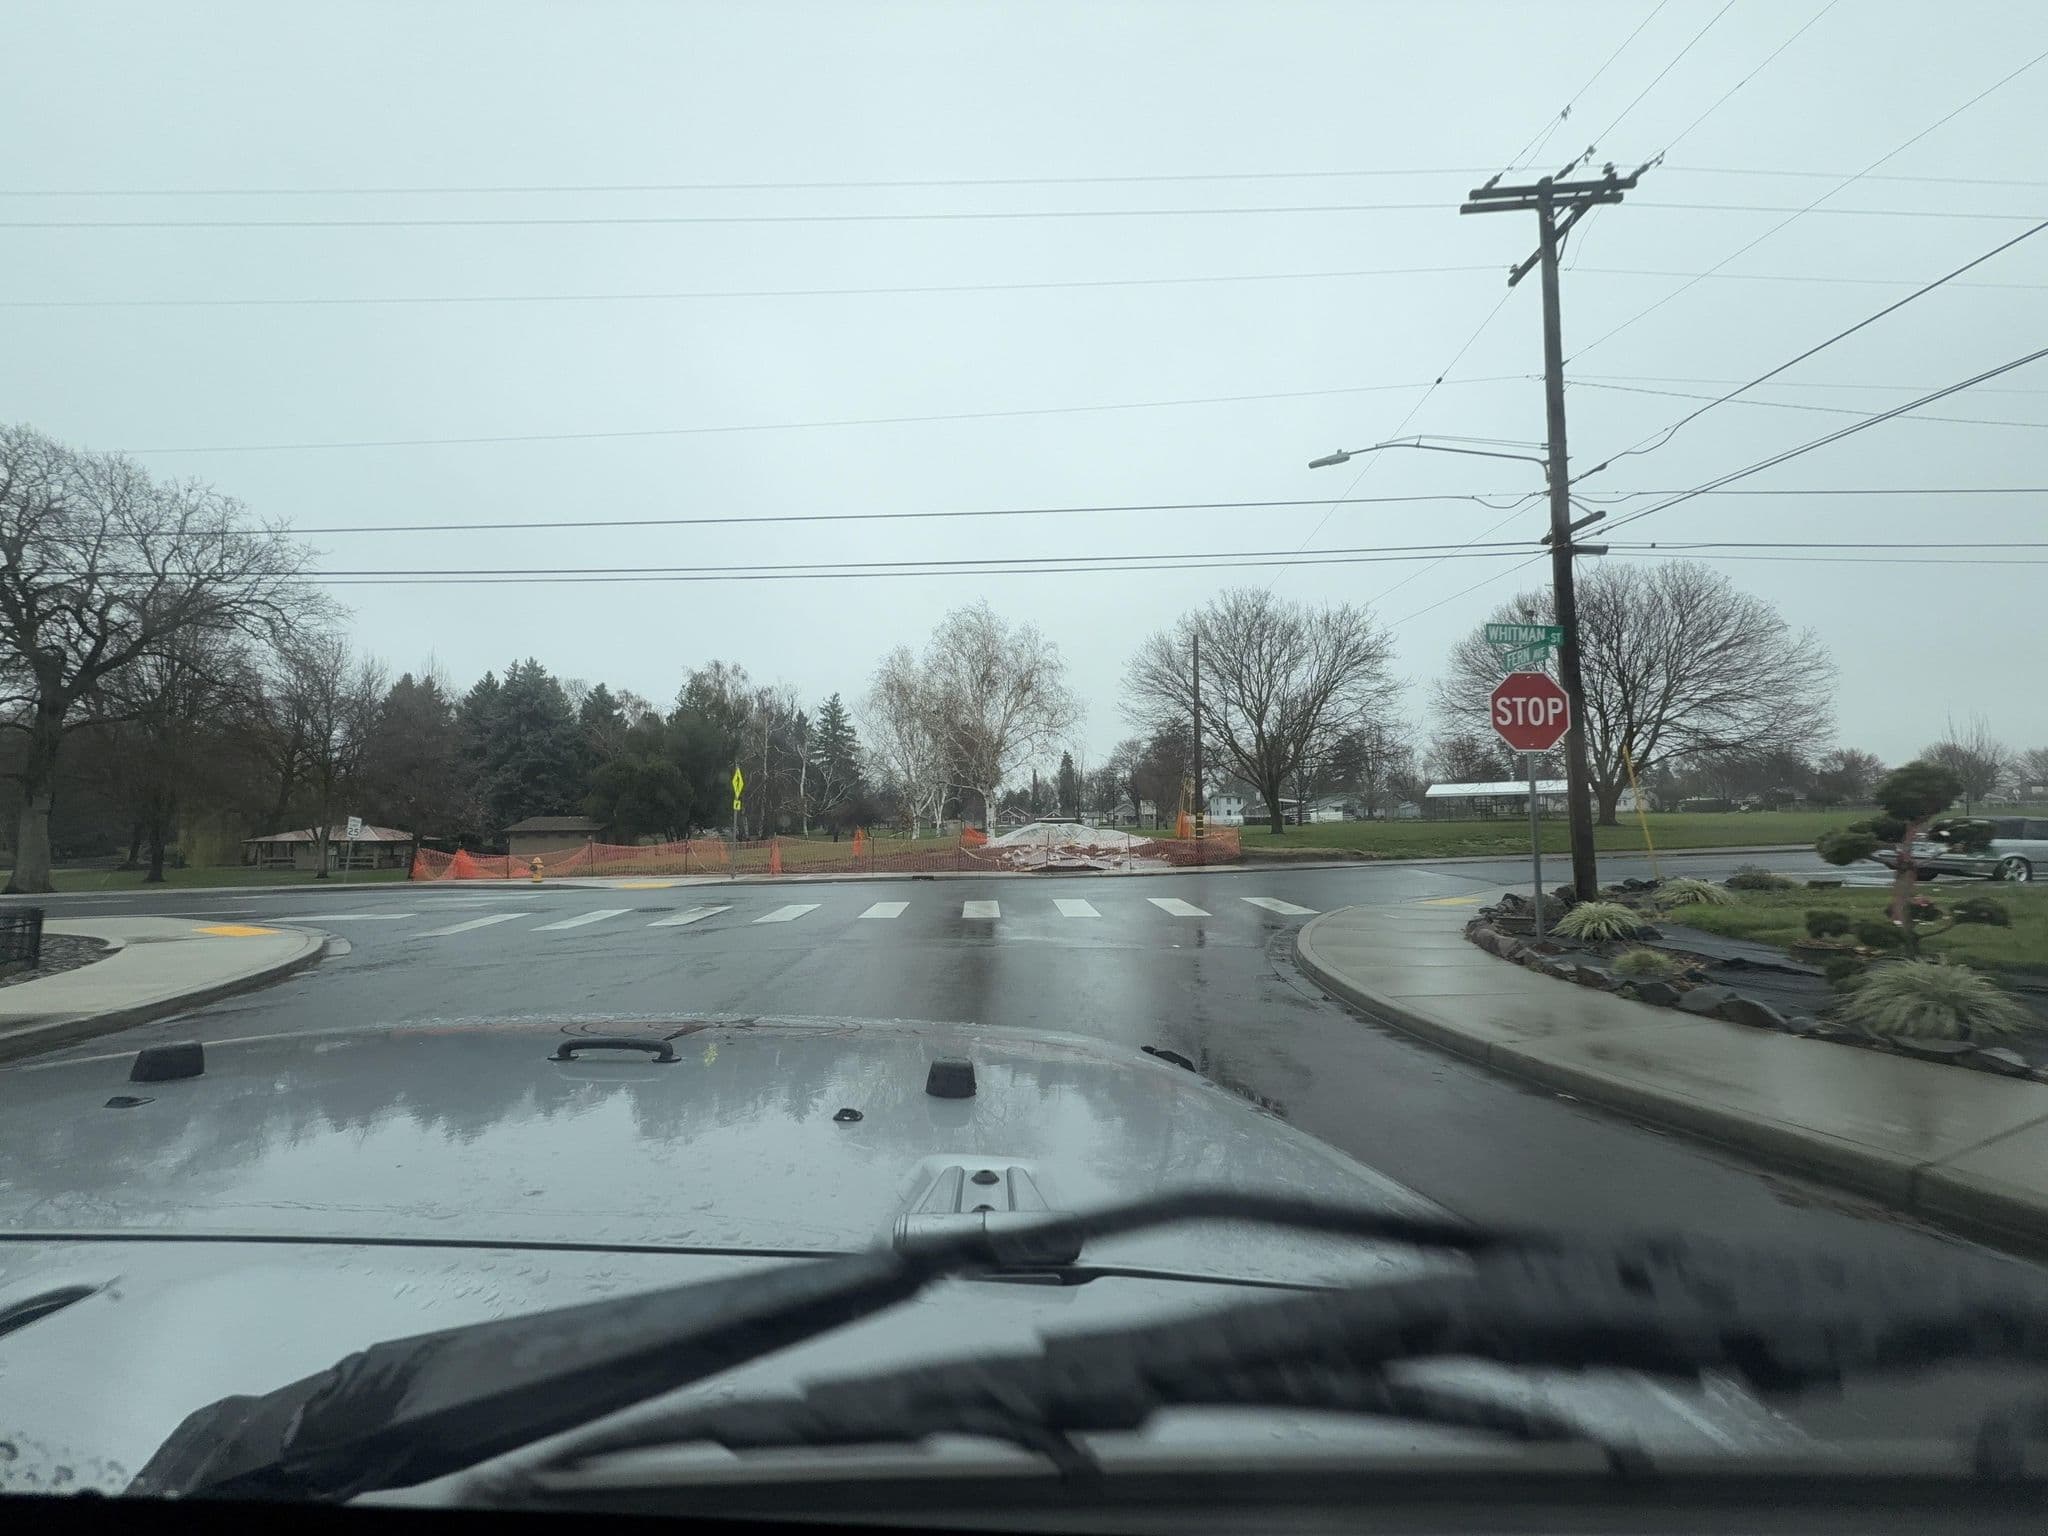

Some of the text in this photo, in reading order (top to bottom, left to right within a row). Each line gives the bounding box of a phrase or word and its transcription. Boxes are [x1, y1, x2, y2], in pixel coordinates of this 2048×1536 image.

[1488, 625, 1562, 643] WHITMAN ST
[1507, 647, 1531, 668] FERN
[1496, 697, 1564, 726] STOP
[348, 827, 359, 836] 25
